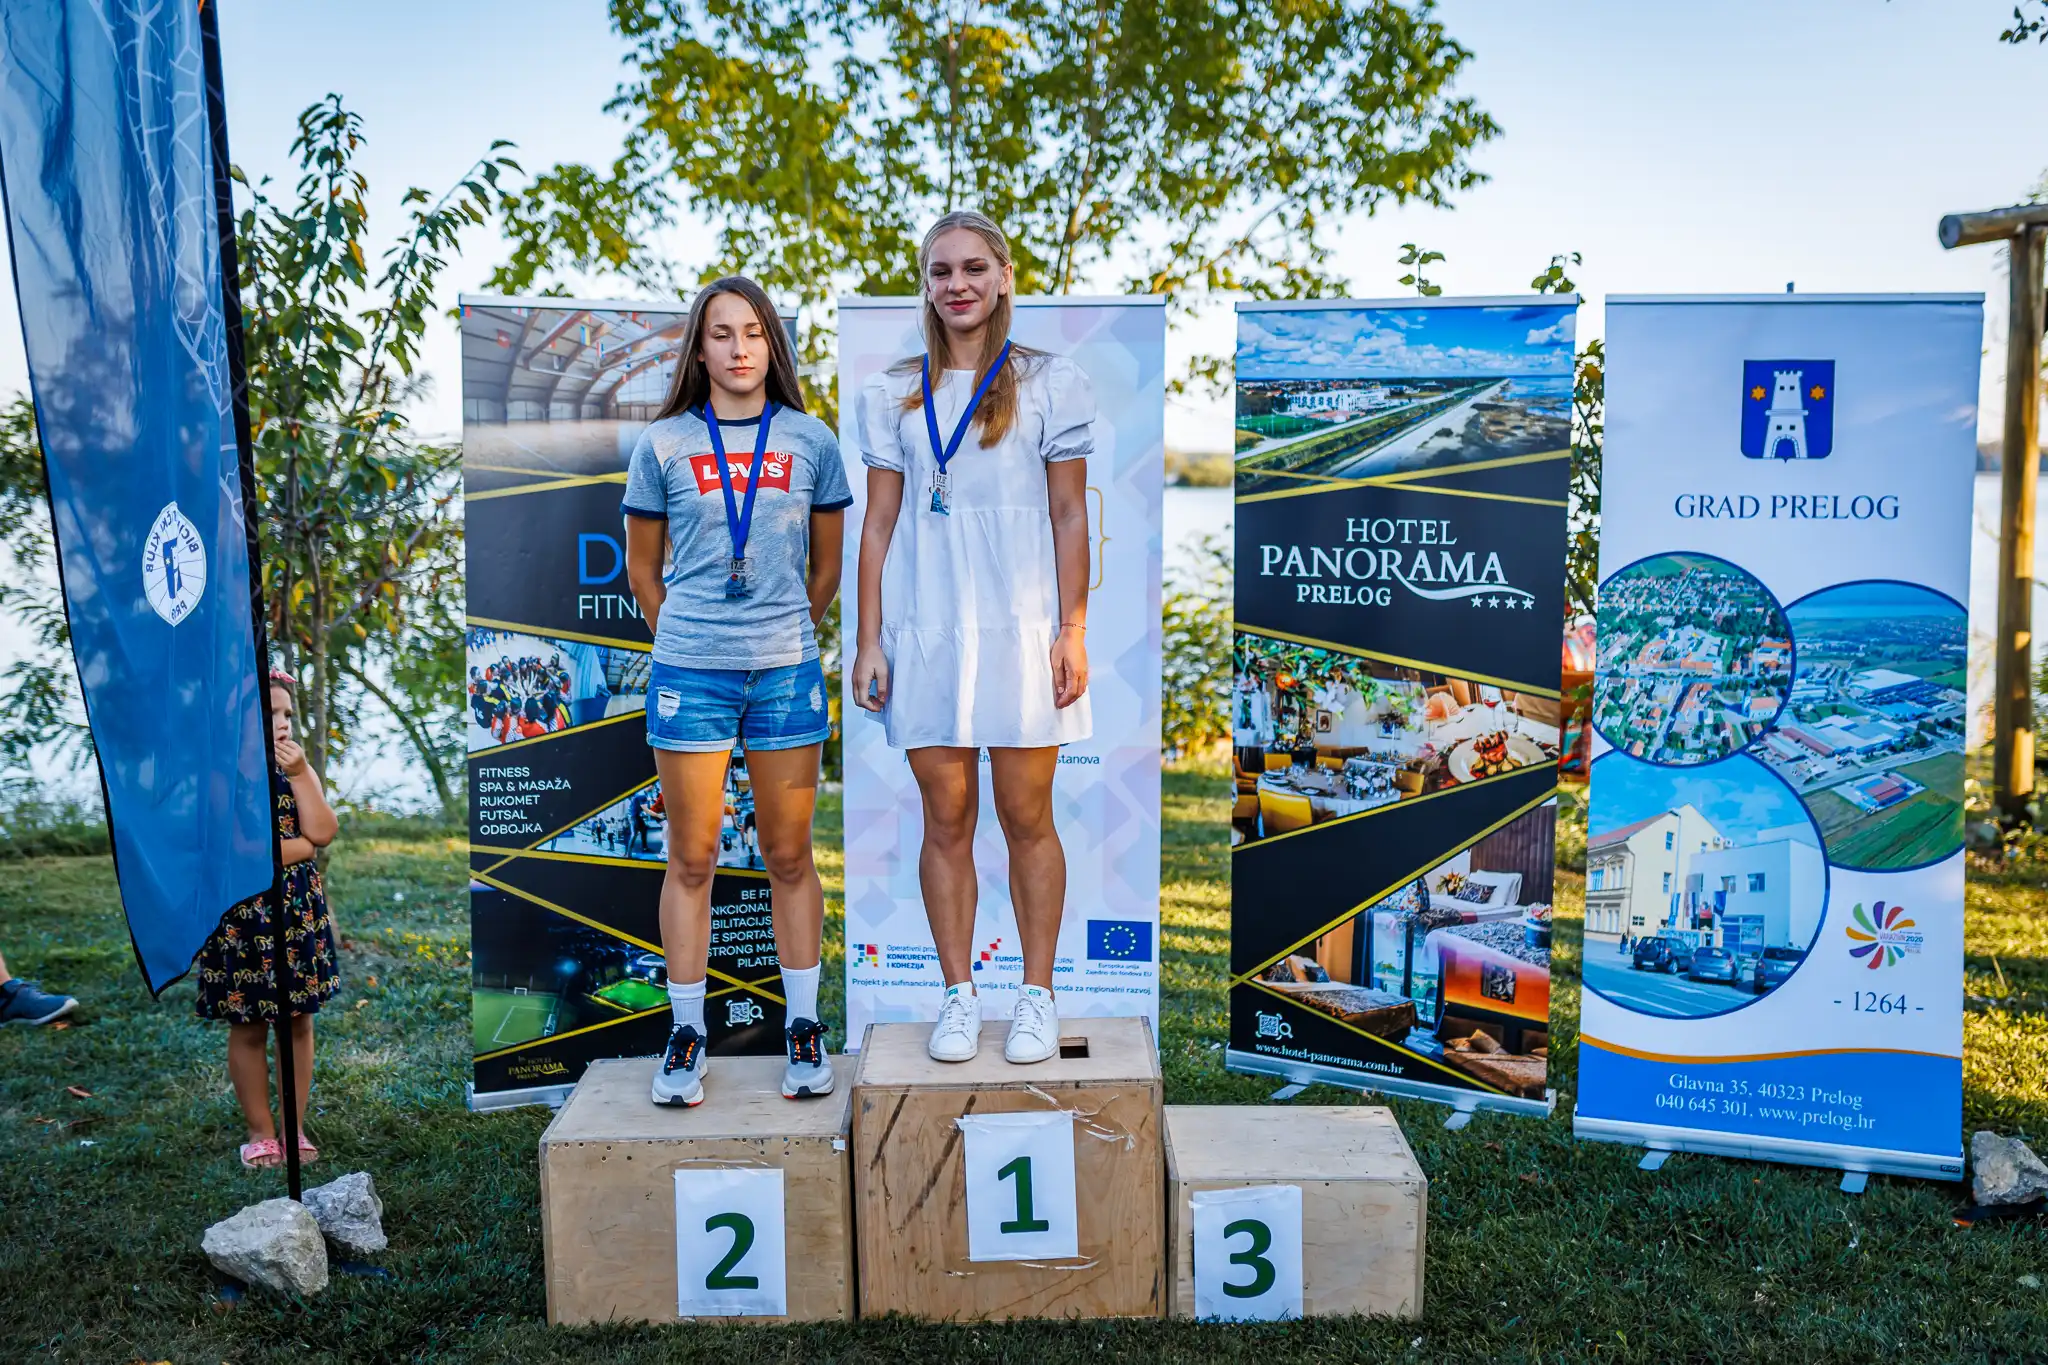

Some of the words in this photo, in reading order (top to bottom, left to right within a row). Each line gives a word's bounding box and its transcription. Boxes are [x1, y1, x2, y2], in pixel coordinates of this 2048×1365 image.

[1674, 494, 1760, 519] GRAD
[1770, 495, 1900, 520] PRELOG
[1346, 518, 1457, 545] HOTEL
[1260, 545, 1509, 585] PANORAMA
[1297, 584, 1391, 606] PRELOG
[579, 594, 645, 619] FITN
[1057, 755, 1100, 764] stanova
[479, 767, 530, 778] FITNESS
[480, 781, 503, 792] SPA
[506, 781, 515, 791] &
[518, 777, 571, 791] MASAŽA
[480, 795, 540, 807] RUKOMET
[480, 809, 527, 820] FUTSAL
[480, 823, 543, 835] ODBOJKA
[741, 889, 756, 900] BE
[711, 903, 772, 915] NKCIONAL
[712, 916, 772, 929] BILITACIJS
[1905, 935, 1923, 943] 2020
[737, 955, 780, 968] PILATES
[891, 962, 925, 970] KOHEZIJA
[852, 978, 880, 987] Projekt
[882, 979, 889, 987] je
[1854, 991, 1907, 1014] 1264
[1255, 1042, 1404, 1074] www.hotel-panorama.com.hr
[1669, 1073, 1725, 1093] Glavna
[1757, 1083, 1805, 1102] 40323
[1811, 1087, 1863, 1110] Prelog
[1655, 1093, 1684, 1110] 040
[1688, 1097, 1716, 1113] 645
[1759, 1106, 1876, 1131] www.prelog.hr
[998, 1156, 1049, 1233] 1
[705, 1212, 759, 1290] 2
[1222, 1218, 1276, 1299] 3
